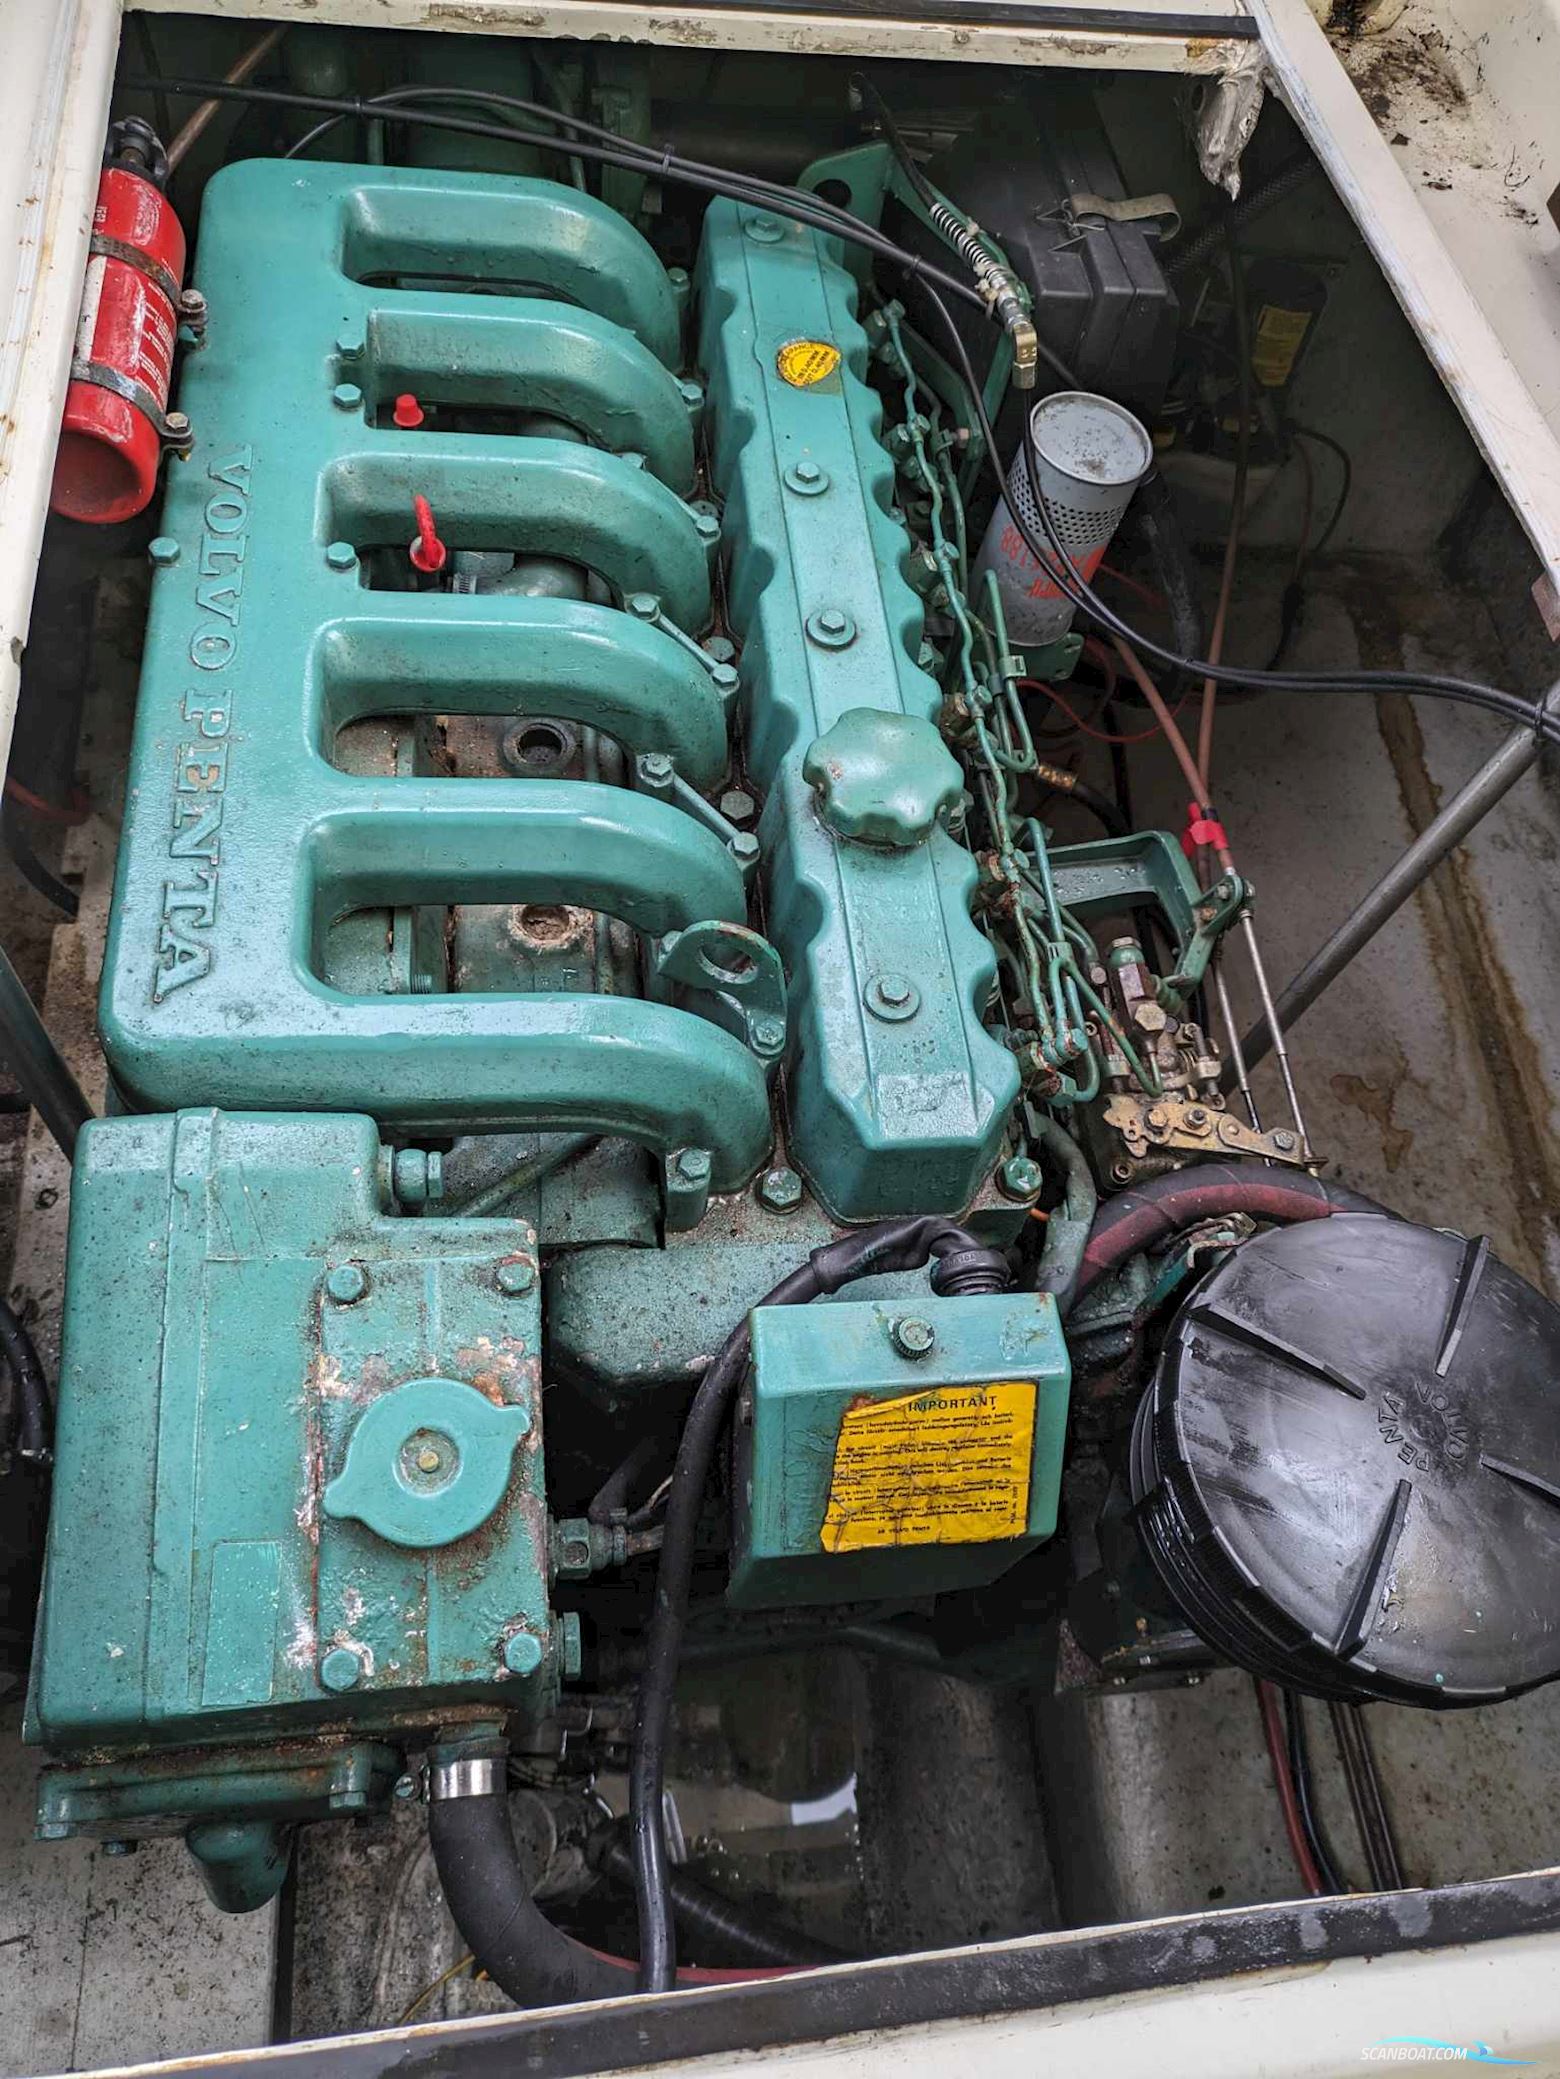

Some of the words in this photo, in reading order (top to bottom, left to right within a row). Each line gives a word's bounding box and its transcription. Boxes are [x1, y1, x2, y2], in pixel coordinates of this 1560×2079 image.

[190, 445, 254, 672] VOLVO
[153, 688, 234, 1005] PENTA
[908, 1395, 997, 1412] IMPORTANT
[1378, 1391, 1430, 1472] PENTA
[1415, 1380, 1470, 1460] VOLVO
